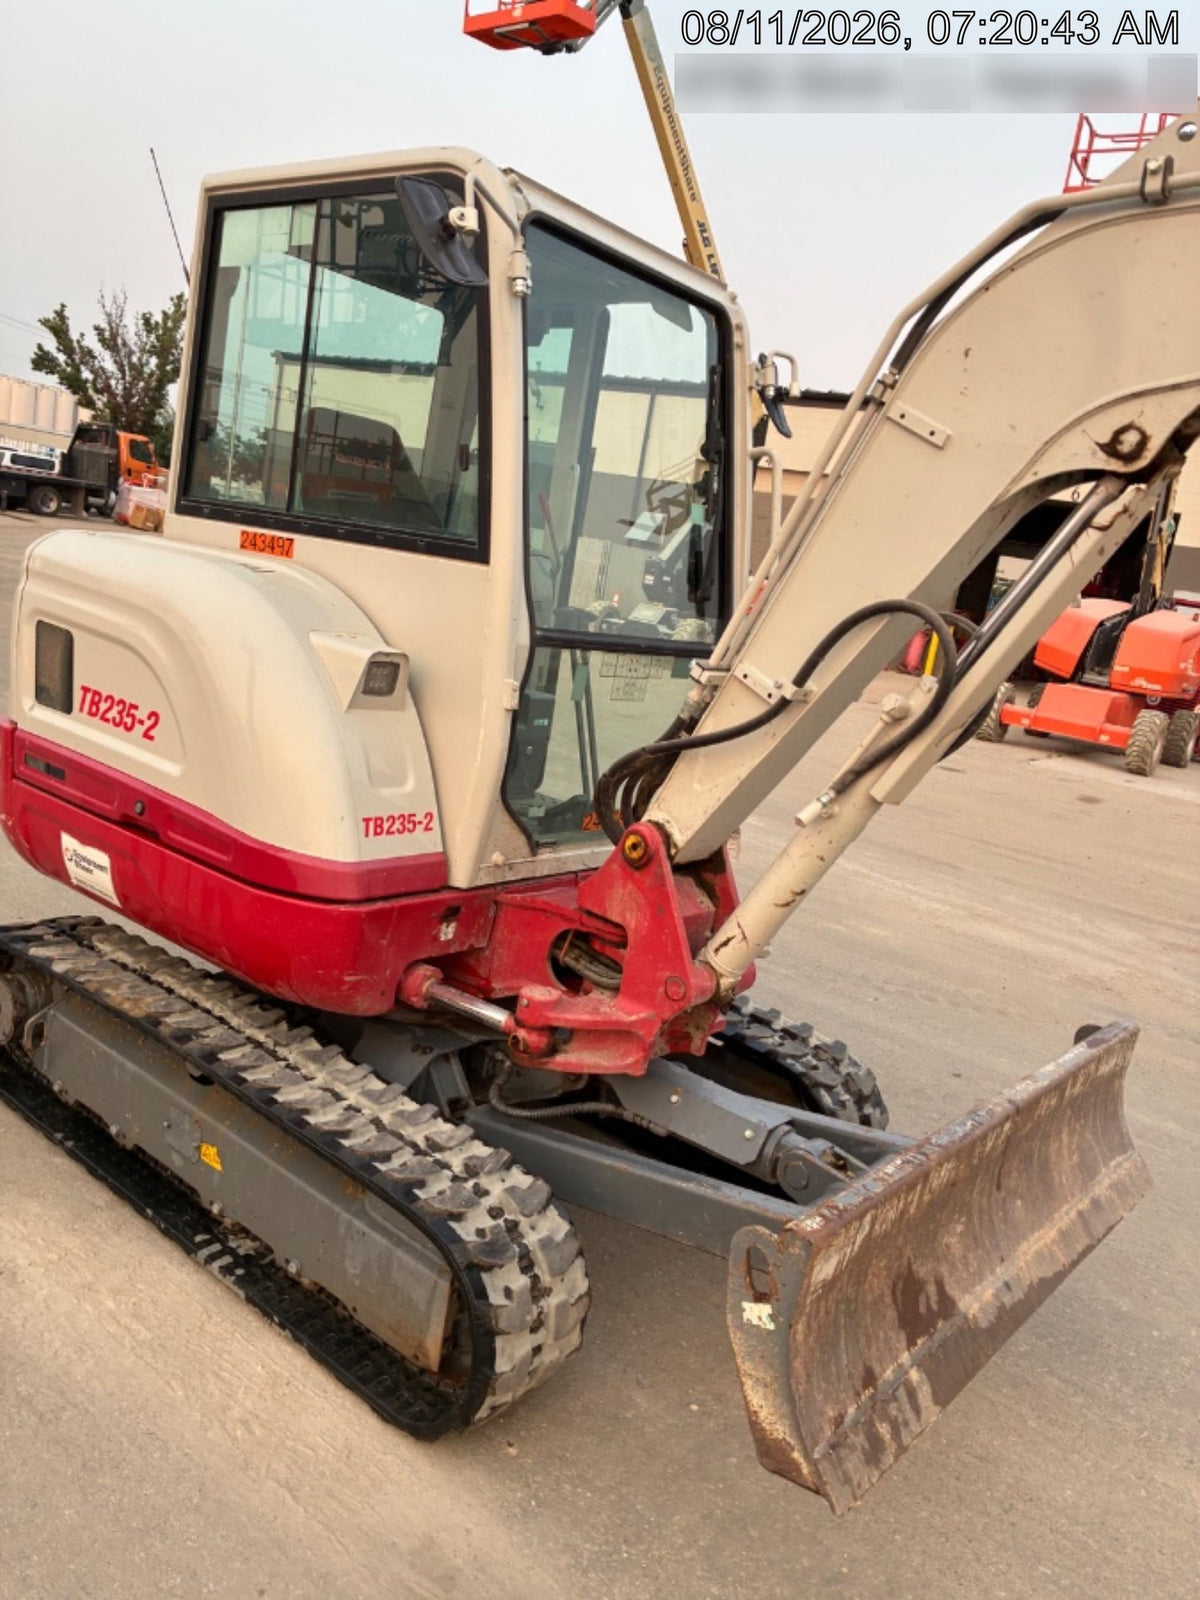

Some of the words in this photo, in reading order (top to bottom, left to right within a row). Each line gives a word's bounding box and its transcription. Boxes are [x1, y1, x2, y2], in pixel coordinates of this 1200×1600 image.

[696, 219, 712, 248] JLG
[240, 530, 294, 557] 243497
[79, 685, 160, 741] TB235-2
[362, 811, 434, 838] TB235-2
